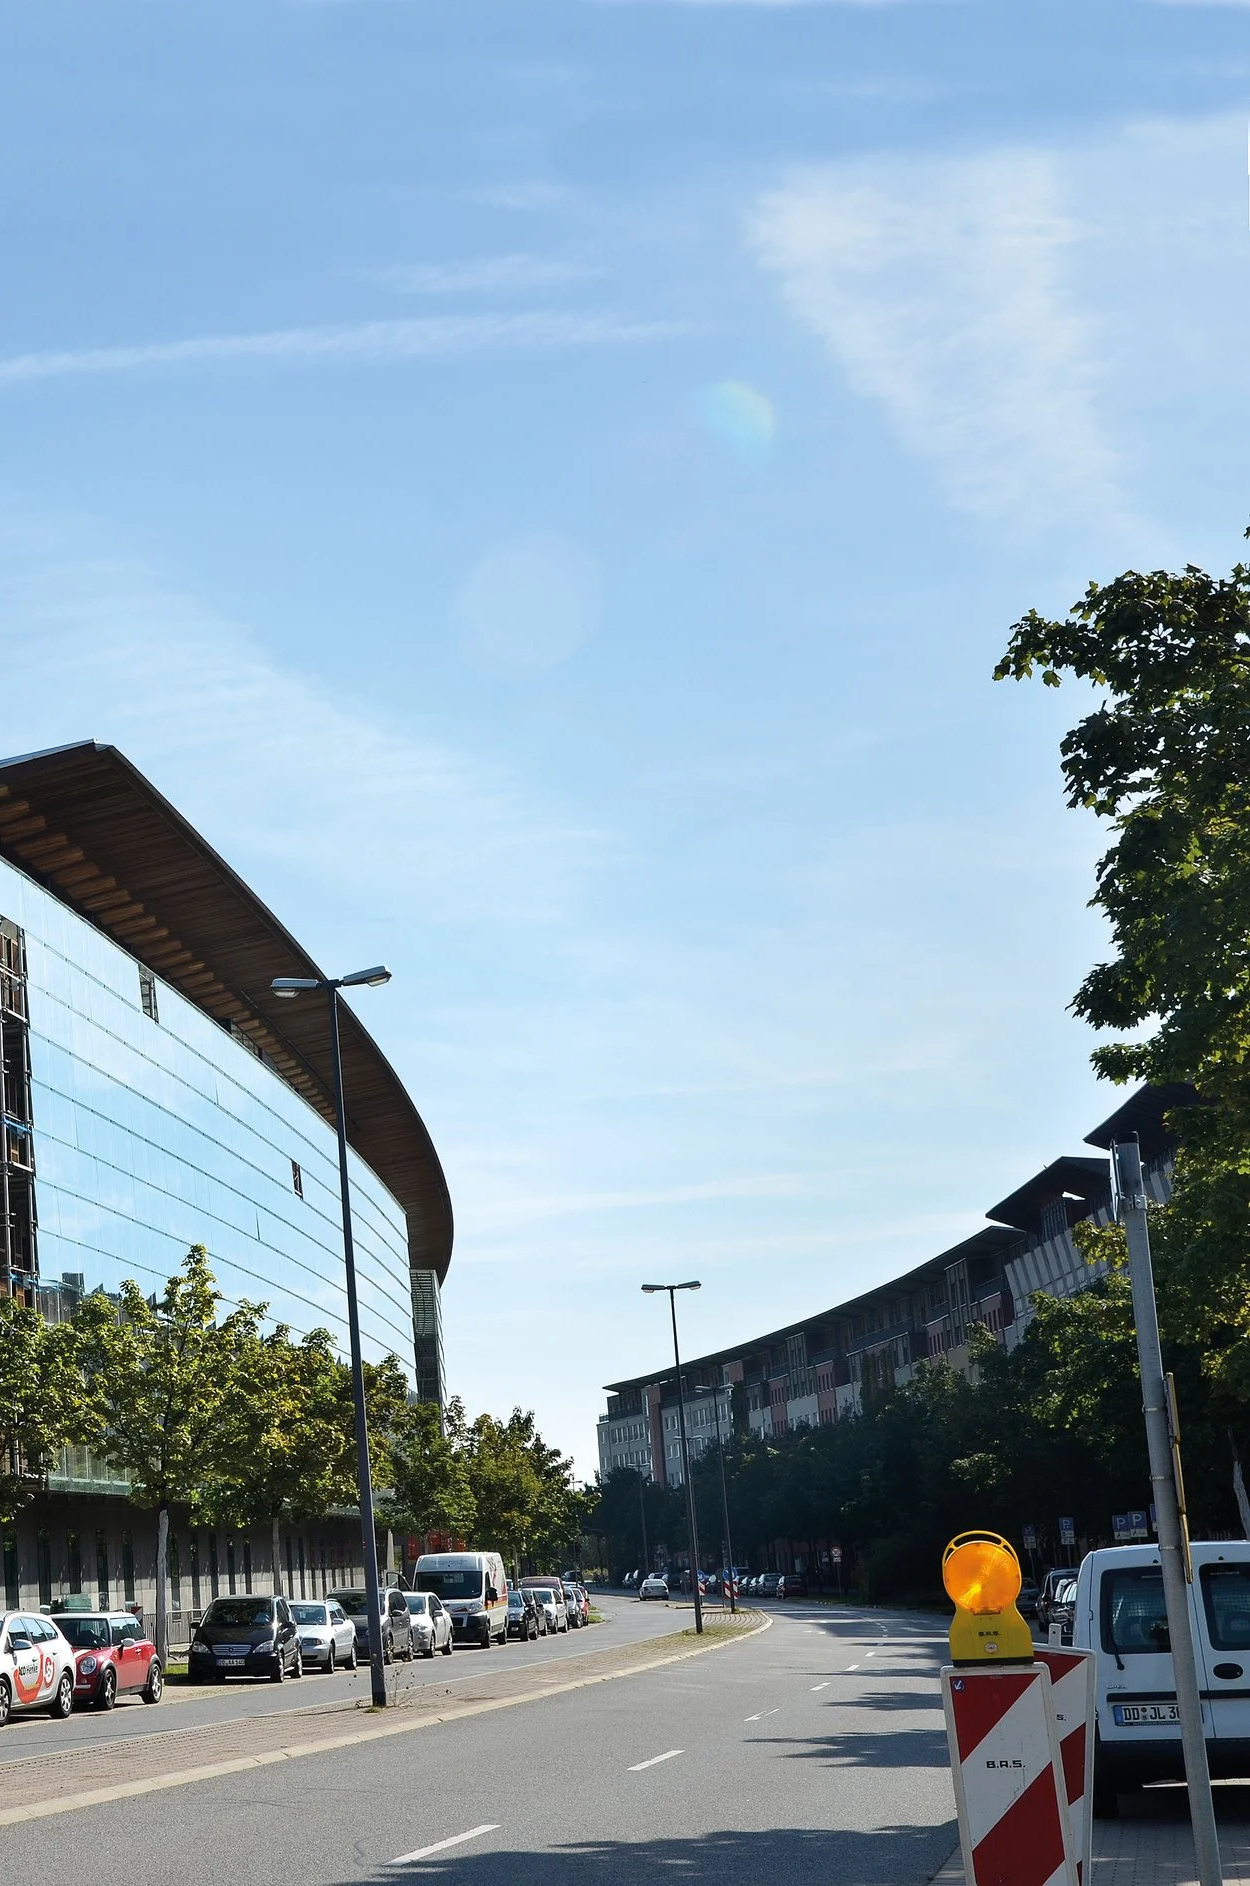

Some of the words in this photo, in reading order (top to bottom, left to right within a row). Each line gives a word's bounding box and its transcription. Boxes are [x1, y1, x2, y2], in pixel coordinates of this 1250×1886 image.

[1116, 1517, 1126, 1529] P
[1132, 1513, 1142, 1526] P
[1123, 1707, 1140, 1720] DD
[1150, 1706, 1165, 1720] JL
[986, 1760, 1026, 1768] B.A.S.
